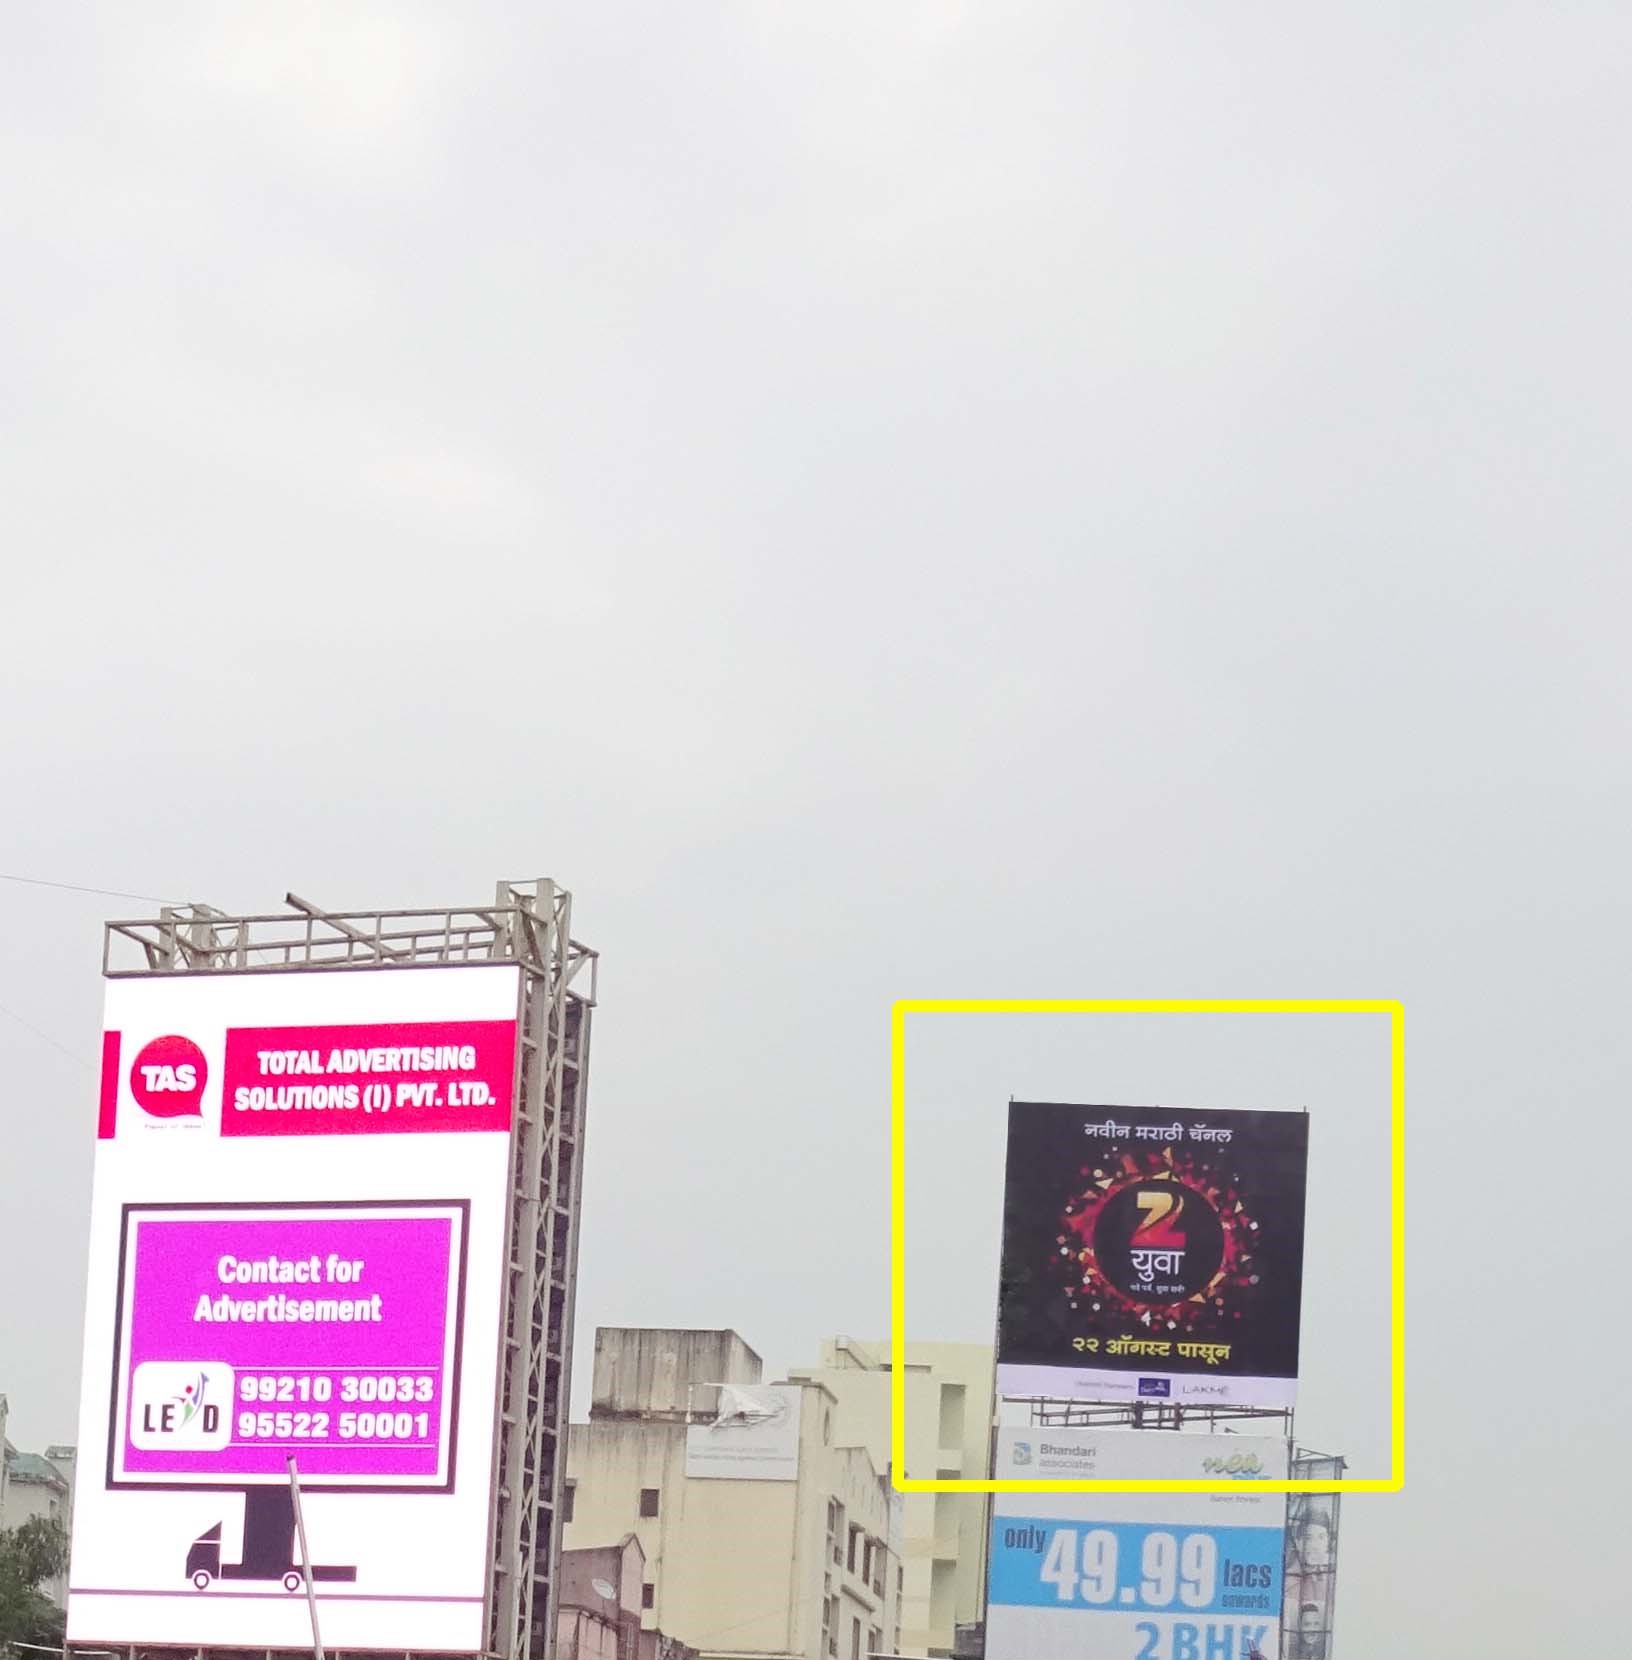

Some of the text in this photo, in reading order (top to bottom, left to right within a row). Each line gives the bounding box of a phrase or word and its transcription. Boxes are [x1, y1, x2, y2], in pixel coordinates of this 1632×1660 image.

[257, 1046, 476, 1075] TOTAL ADVERTISING
[141, 1064, 197, 1092] TAS
[234, 1081, 497, 1113] SOLUTIONS (I) PVT. LTD.
[1084, 1119, 1233, 1143] नवीन मराठी चॅनल
[217, 1254, 365, 1283] Contact for
[1130, 1249, 1186, 1282] युवा
[193, 1293, 383, 1322] Advertisement
[1072, 1334, 1232, 1365] २२ ऑगस्ट पासून
[240, 1375, 434, 1402] 99210 30033
[238, 1412, 429, 1438] 95522 50001
[1039, 1458, 1096, 1470] associates
[1040, 1443, 1096, 1457] Bhandari
[1004, 1525, 1273, 1608] only 49.99 lacs
